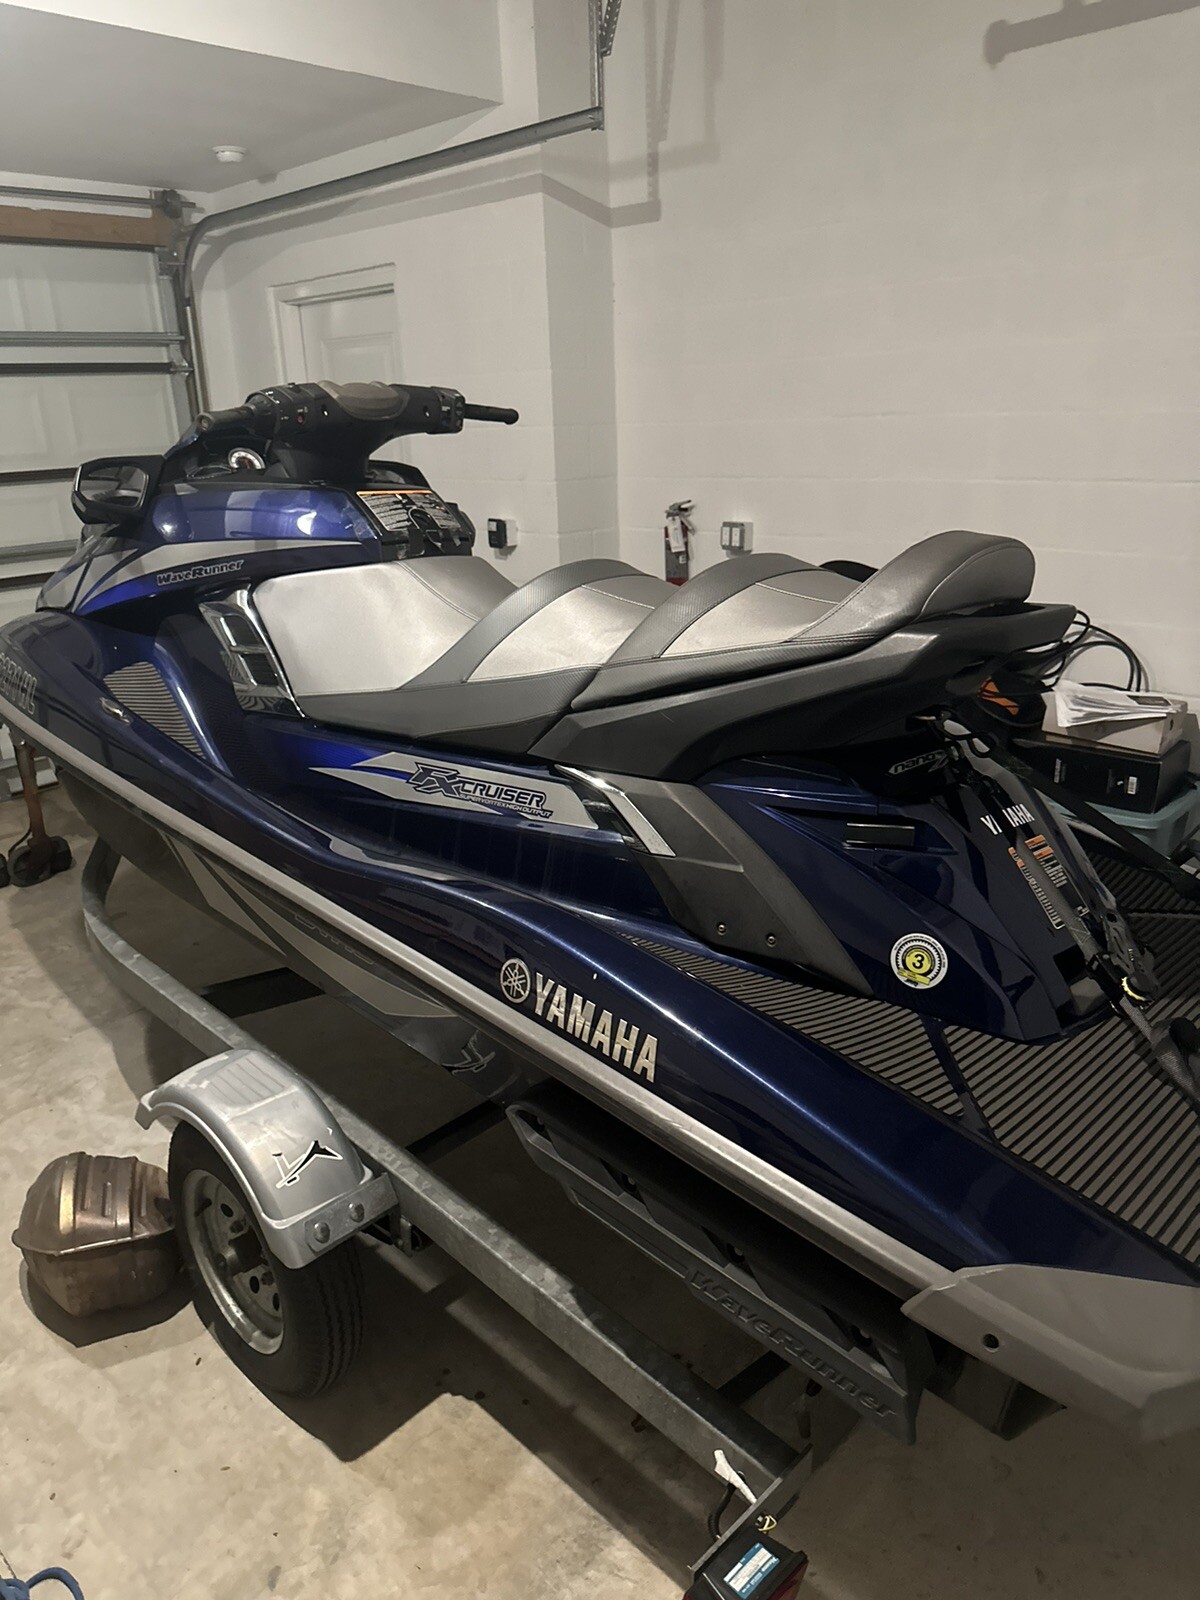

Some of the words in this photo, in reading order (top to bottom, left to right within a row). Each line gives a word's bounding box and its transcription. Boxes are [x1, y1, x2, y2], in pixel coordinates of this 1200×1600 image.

[157, 560, 244, 585] WaveRunner
[406, 762, 460, 798] FX
[460, 782, 546, 808] CRUISER
[522, 805, 552, 818] OUTPUT
[980, 803, 1036, 835] YAHA
[911, 953, 925, 970] 3
[534, 972, 658, 1083] YAMAHA
[690, 1271, 896, 1418] WaveRunner
